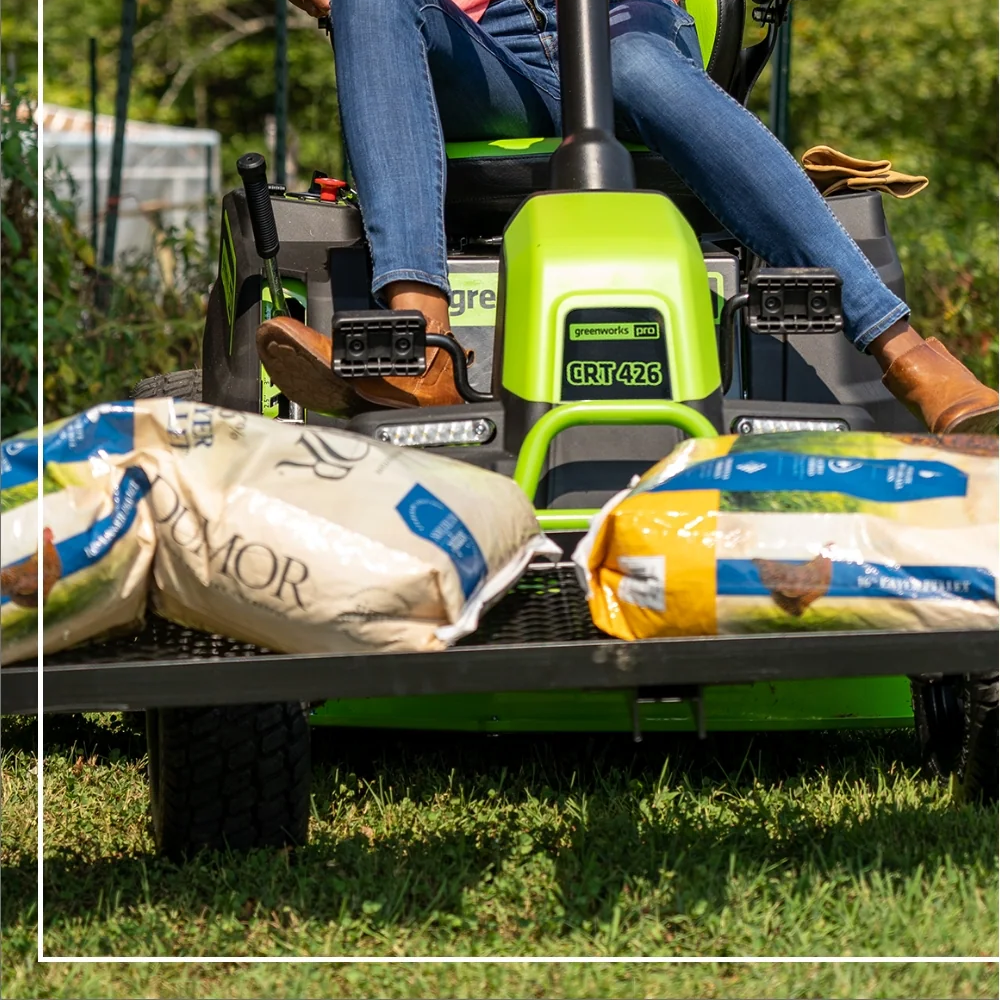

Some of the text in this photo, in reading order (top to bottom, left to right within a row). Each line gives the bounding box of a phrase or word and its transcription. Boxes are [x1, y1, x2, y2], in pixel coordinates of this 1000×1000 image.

[574, 326, 656, 338] greenworks pro
[567, 361, 662, 386] CRT 426
